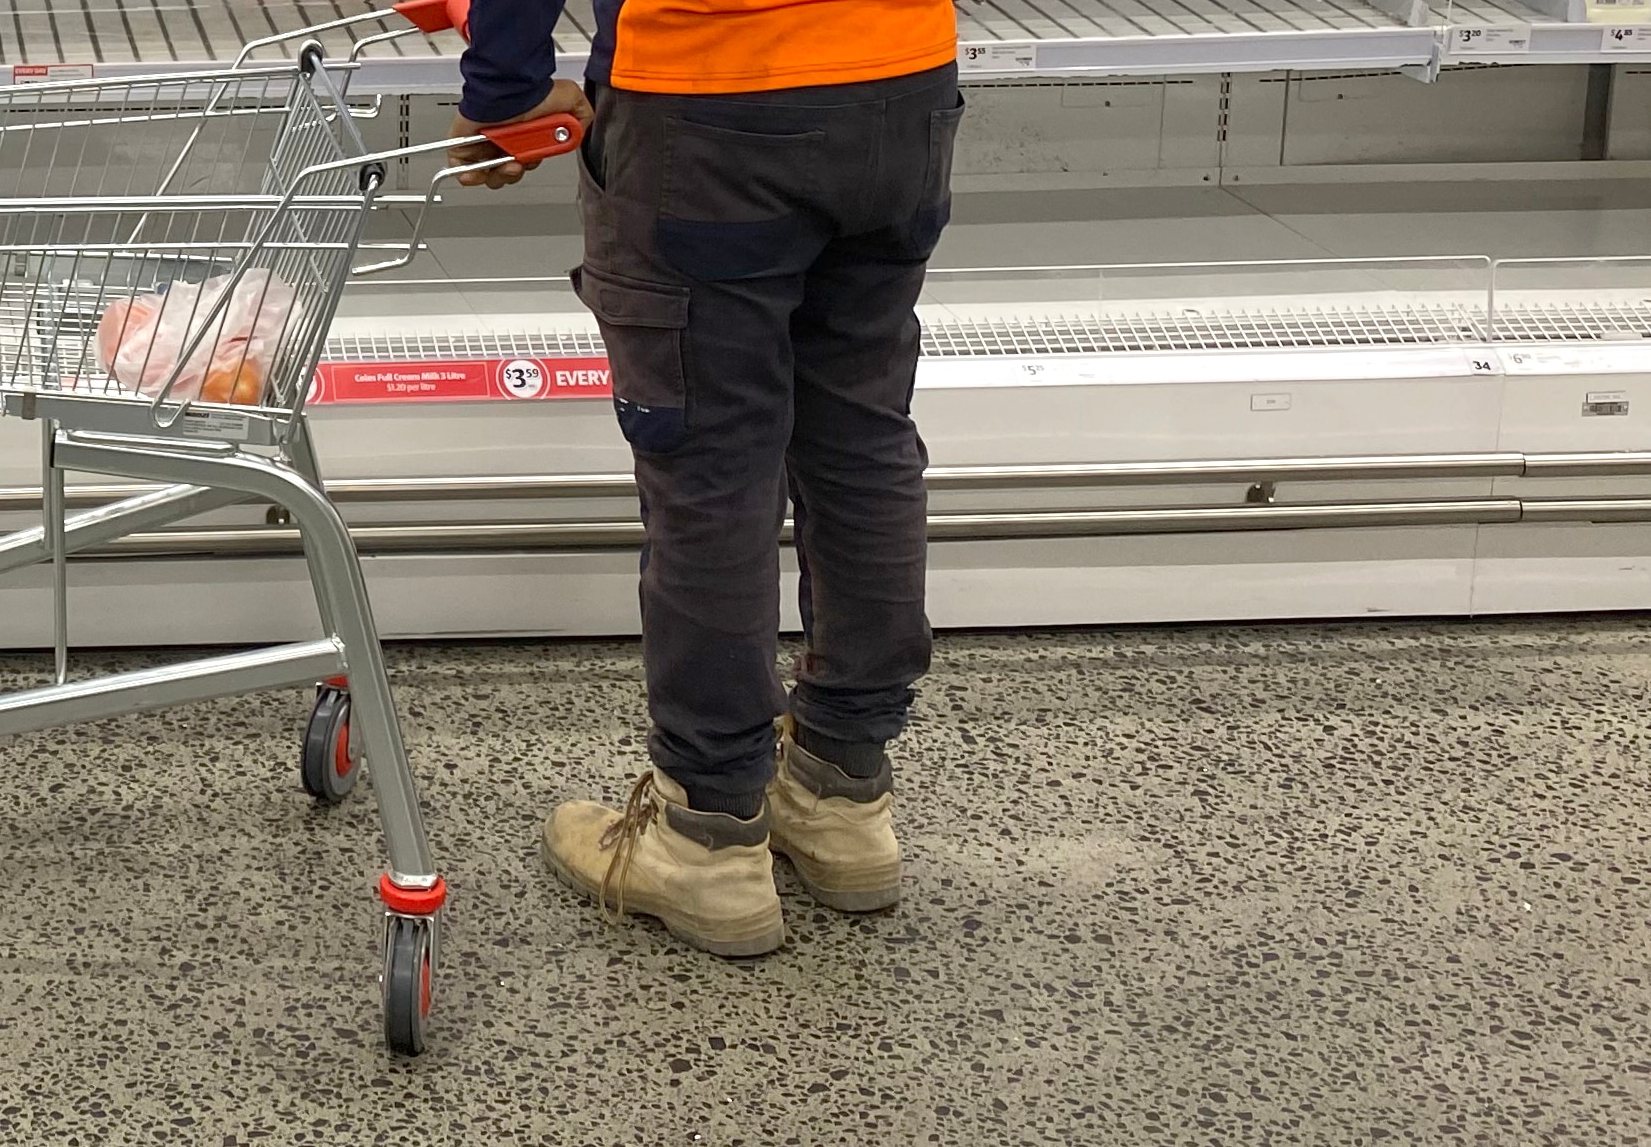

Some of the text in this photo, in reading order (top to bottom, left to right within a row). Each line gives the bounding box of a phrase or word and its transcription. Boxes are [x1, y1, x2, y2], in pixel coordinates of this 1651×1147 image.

[1472, 360, 1491, 371] 34
[354, 371, 466, 383] Coles Full Cream Milk 3 Litre
[555, 369, 610, 386] EVERY
[386, 382, 436, 394] $1.20 per litre
